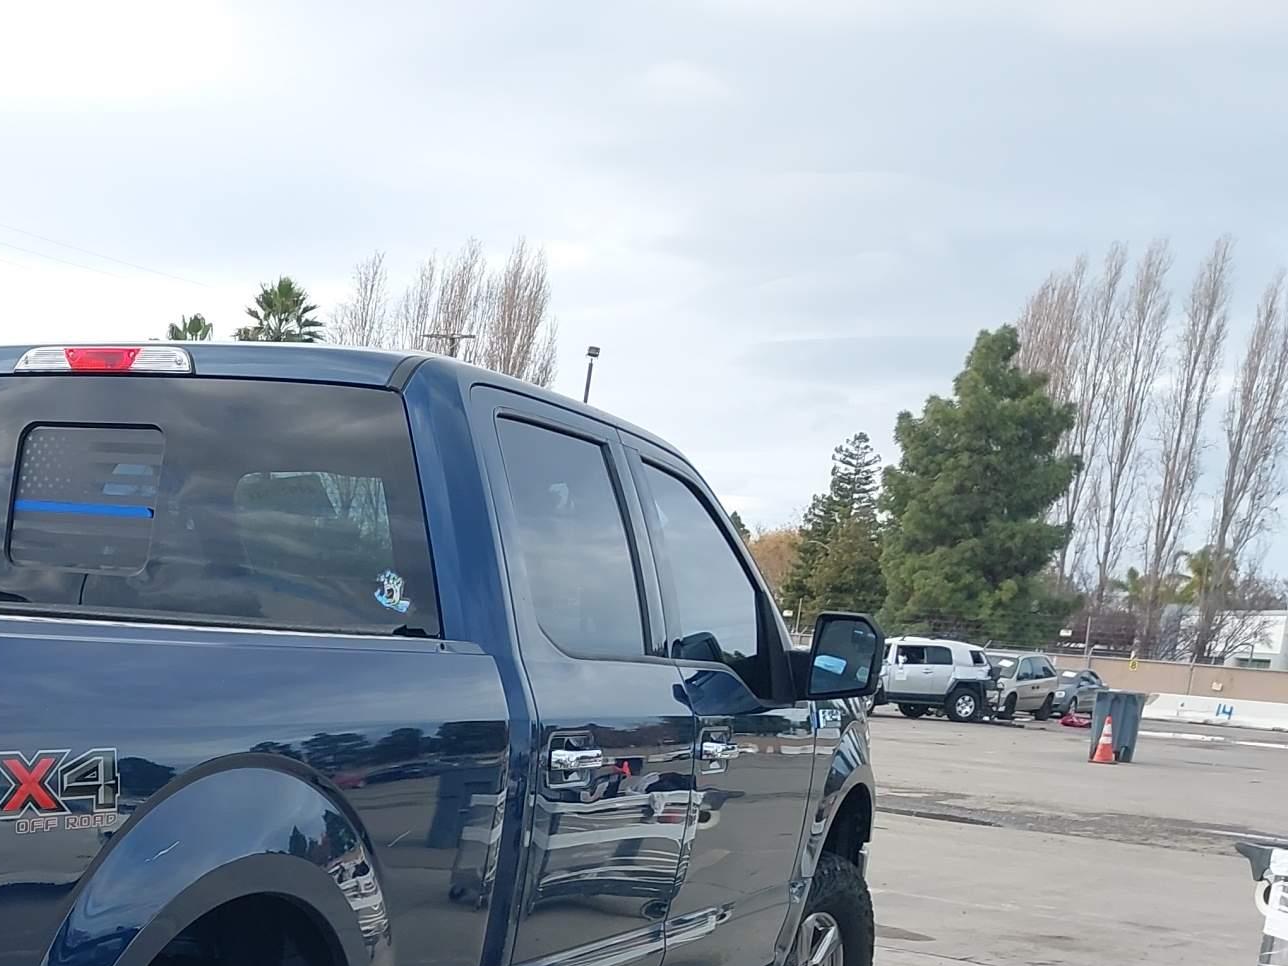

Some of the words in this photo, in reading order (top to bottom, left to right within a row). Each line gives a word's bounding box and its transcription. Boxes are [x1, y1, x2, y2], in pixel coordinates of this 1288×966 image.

[1216, 703, 1234, 720] 14
[16, 817, 58, 834] OFF
[65, 813, 118, 830] ROAD
